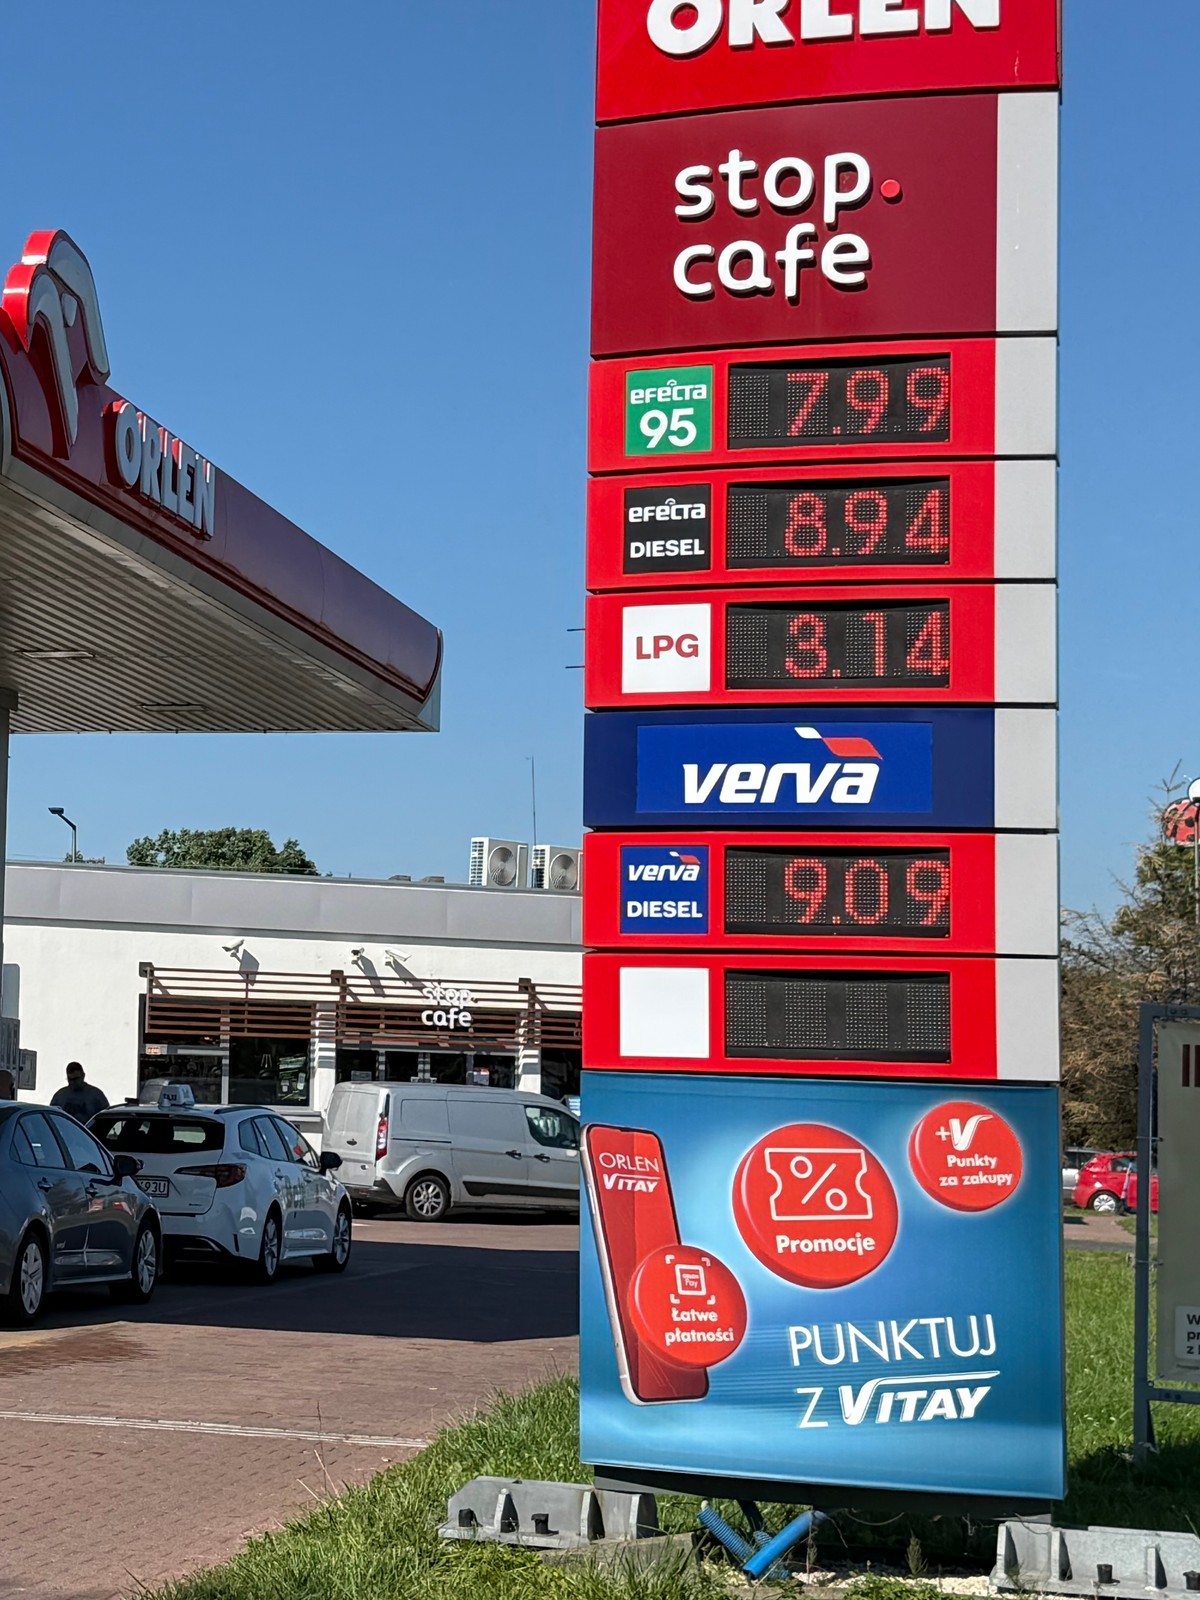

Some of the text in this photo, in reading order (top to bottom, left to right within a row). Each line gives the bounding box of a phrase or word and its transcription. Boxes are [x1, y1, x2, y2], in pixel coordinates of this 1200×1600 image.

[673, 223, 871, 298] cafe
[786, 366, 949, 437] 7.99
[639, 408, 697, 449] 95
[113, 401, 216, 538] ORLEN
[784, 489, 949, 557] 8.94
[629, 538, 705, 559] DIESEL
[635, 633, 699, 660] LPG
[784, 611, 950, 679] 3.14
[682, 761, 881, 804] verva
[627, 863, 701, 883] verva
[783, 858, 950, 926] 9.09
[626, 900, 703, 919] DIESEL
[421, 1007, 472, 1030] cafe
[599, 1152, 660, 1173] ORLEN
[946, 1154, 997, 1169] Punkty
[140, 1181, 166, 1193] 93U
[602, 1173, 661, 1193] VITAY
[939, 1171, 1013, 1187] za zakupy
[775, 1233, 876, 1257] Promocje
[671, 1307, 719, 1322] Łatwe
[665, 1327, 735, 1347] płatności
[788, 1313, 998, 1368] PUNKTUJ
[838, 1370, 1001, 1426] VITAY
